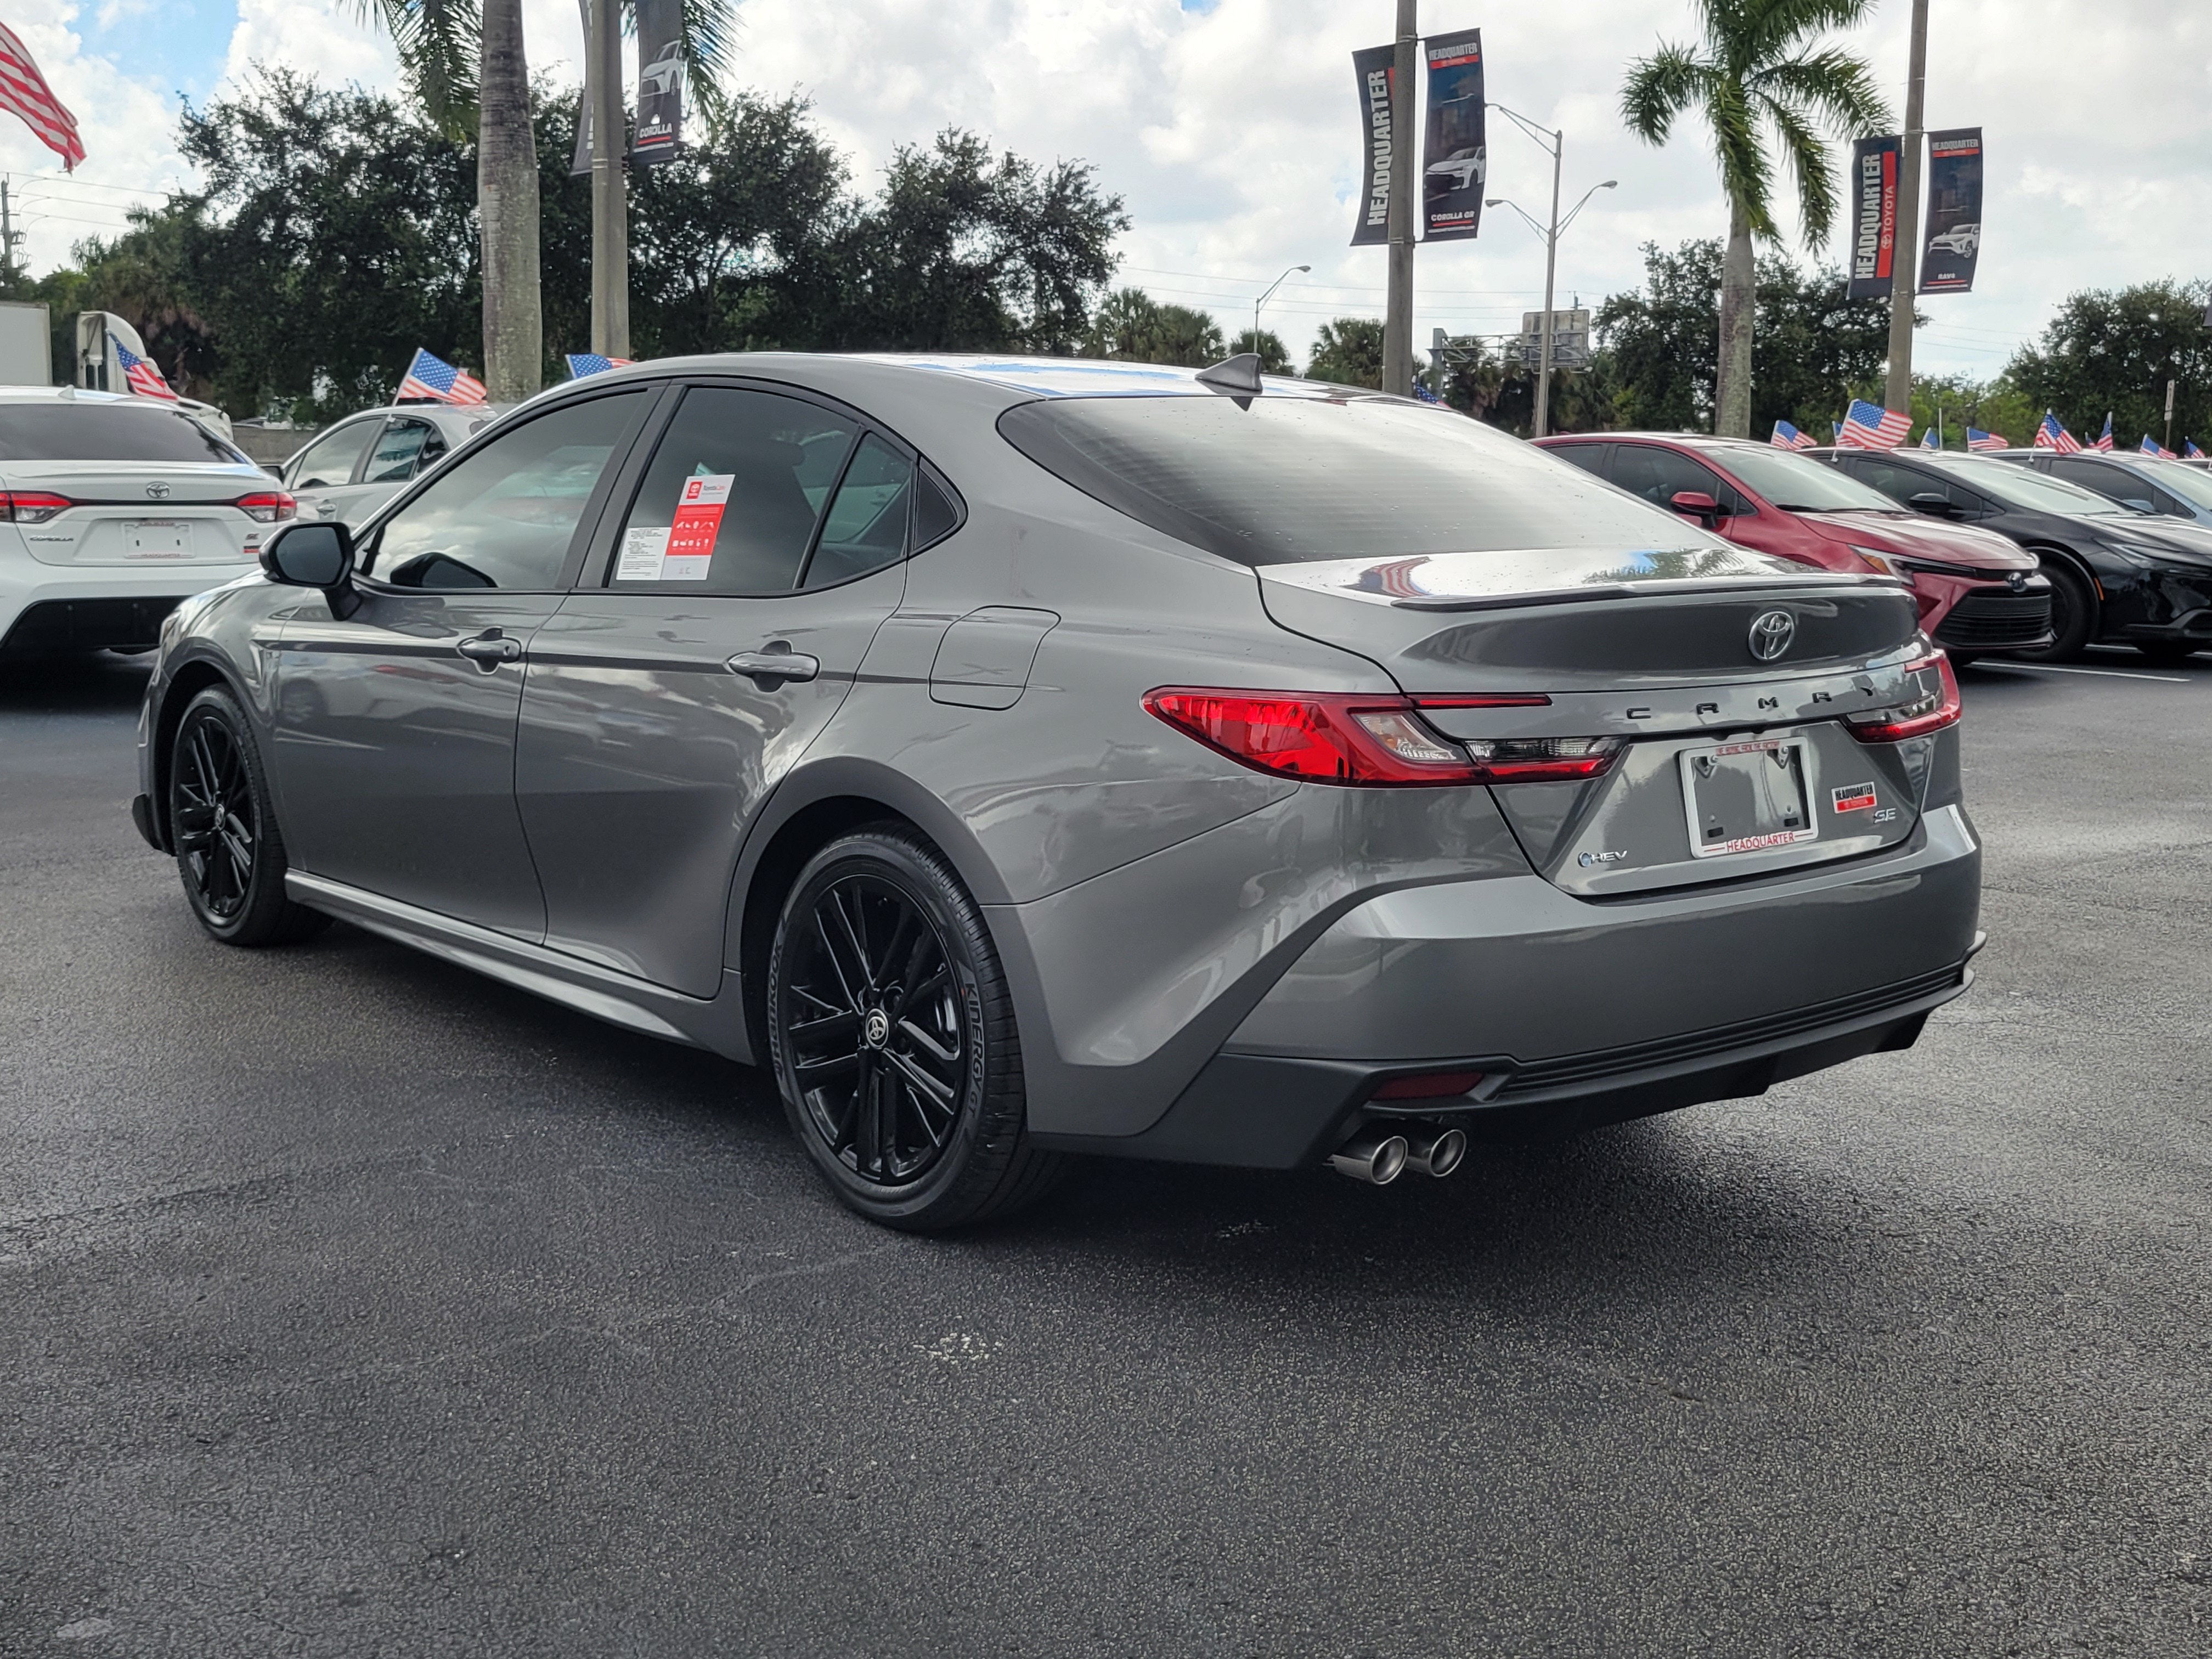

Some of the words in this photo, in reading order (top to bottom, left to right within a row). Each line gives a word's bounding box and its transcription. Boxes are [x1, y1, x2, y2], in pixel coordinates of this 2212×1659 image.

[1367, 70, 1393, 226] HEADQUARTER
[1854, 153, 1882, 280] HEADQUARTER
[1882, 185, 1894, 233] TOYOTA
[1626, 685, 1876, 720] CAMRY
[1873, 808, 1897, 824] SE
[1590, 850, 1628, 864] HEV
[1726, 832, 1795, 853] HEADQUARTER
[965, 983, 984, 1092] KINERGY
[968, 1090, 978, 1119] GT
